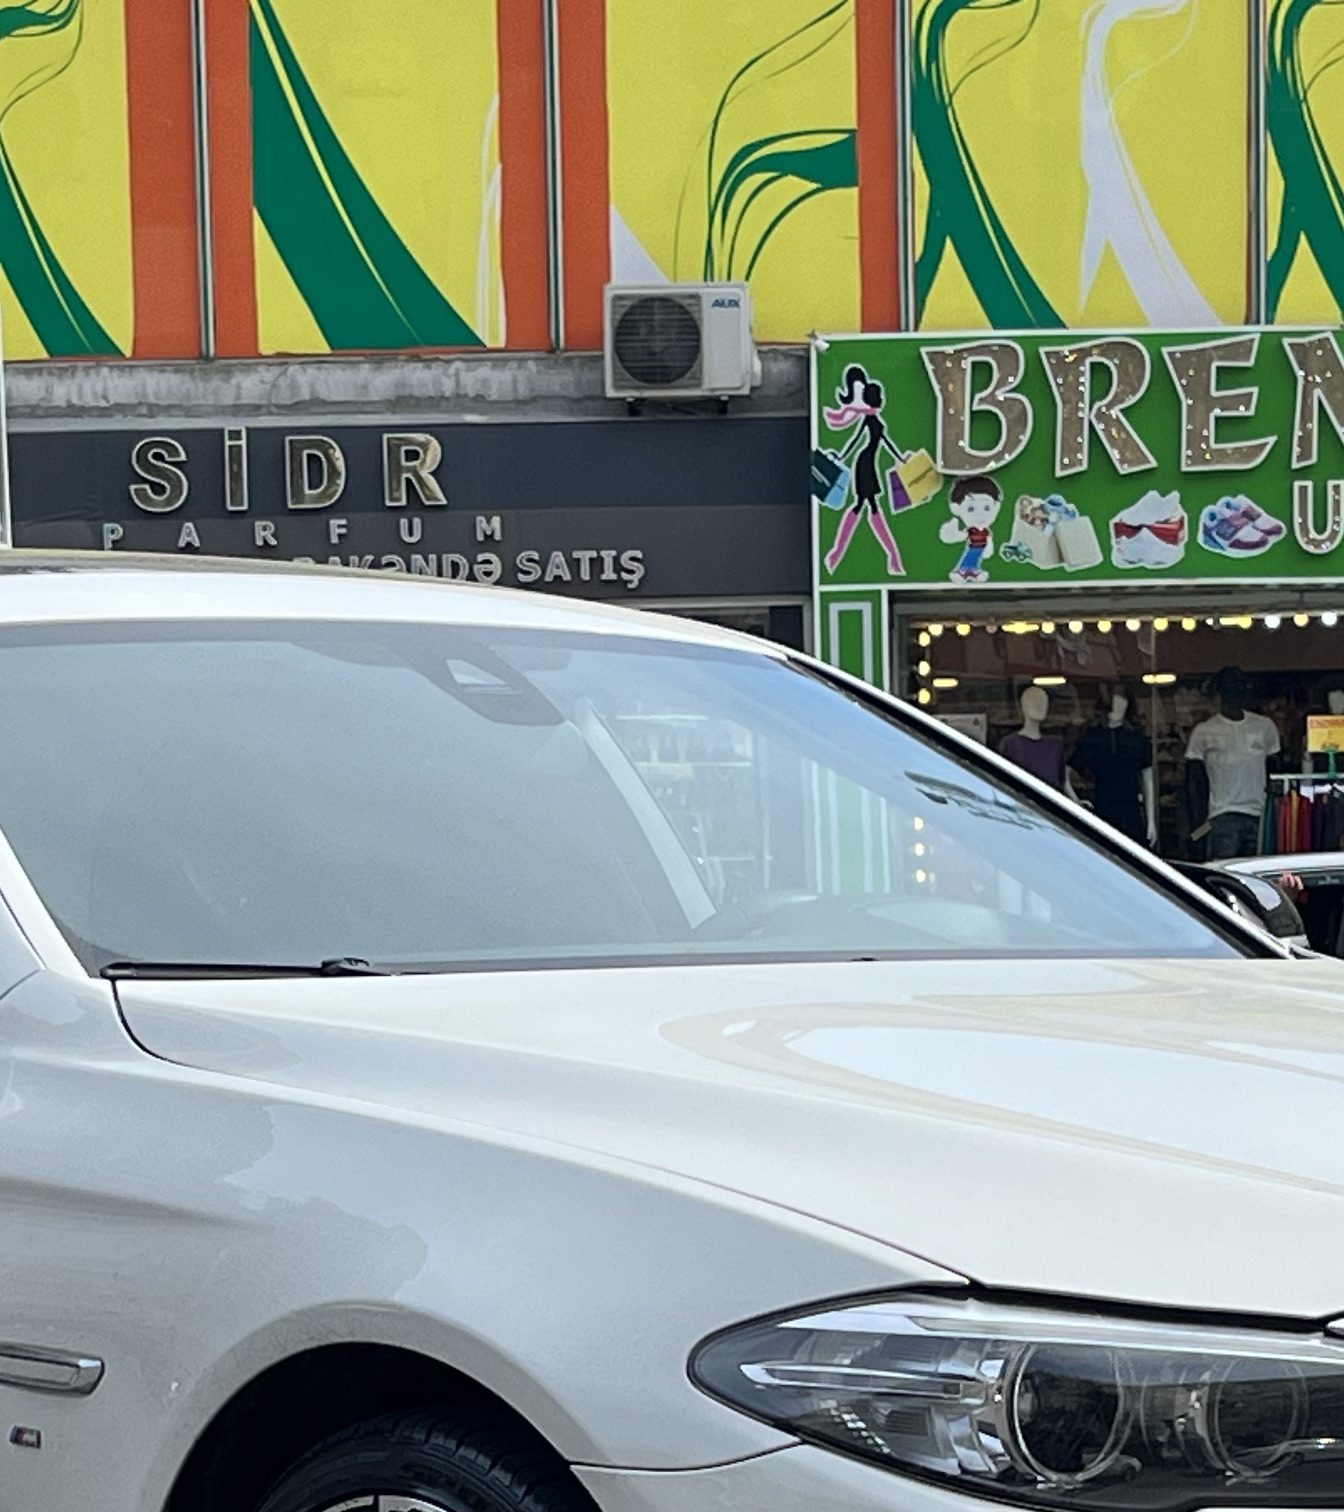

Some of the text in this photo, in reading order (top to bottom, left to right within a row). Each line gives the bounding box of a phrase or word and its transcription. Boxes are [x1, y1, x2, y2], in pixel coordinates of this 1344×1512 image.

[129, 426, 448, 514] SİDR
[102, 515, 502, 550] PARFUM
[517, 550, 646, 589] SATIŞ
